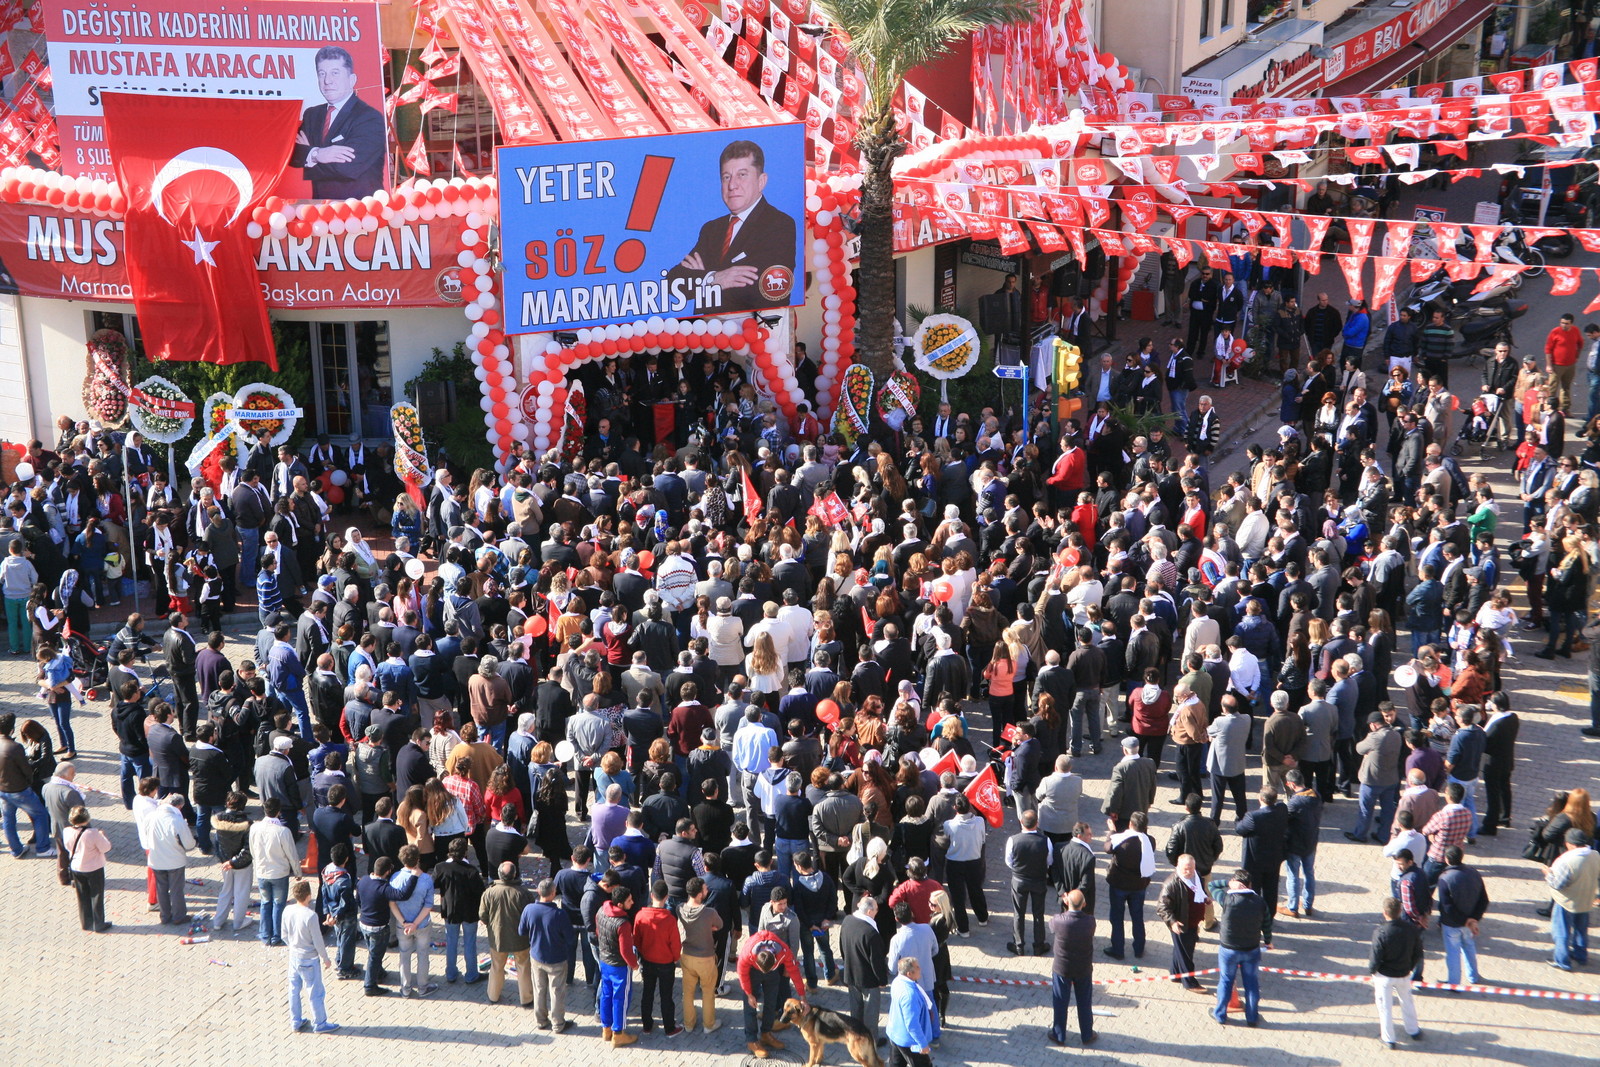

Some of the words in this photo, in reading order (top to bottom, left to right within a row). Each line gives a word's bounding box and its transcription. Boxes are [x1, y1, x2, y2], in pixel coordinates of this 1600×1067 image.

[62, 5, 153, 44] DEĞİŞTİR
[159, 8, 250, 40] KADERİNİ
[257, 9, 361, 42] MARMARİS
[1373, 21, 1402, 58] BBQ
[69, 50, 180, 78] MUSTAFA
[186, 53, 295, 79] KARACAN
[1526, 105, 1541, 113] DP
[73, 121, 103, 143] TÜM
[76, 148, 85, 165] 8
[515, 161, 616, 205] YETER
[26, 214, 126, 268] MUS
[254, 224, 432, 272] ARACAN
[525, 228, 607, 280] SÖZ
[342, 284, 401, 306] Adayı
[520, 270, 722, 327] MARMARİS'in
